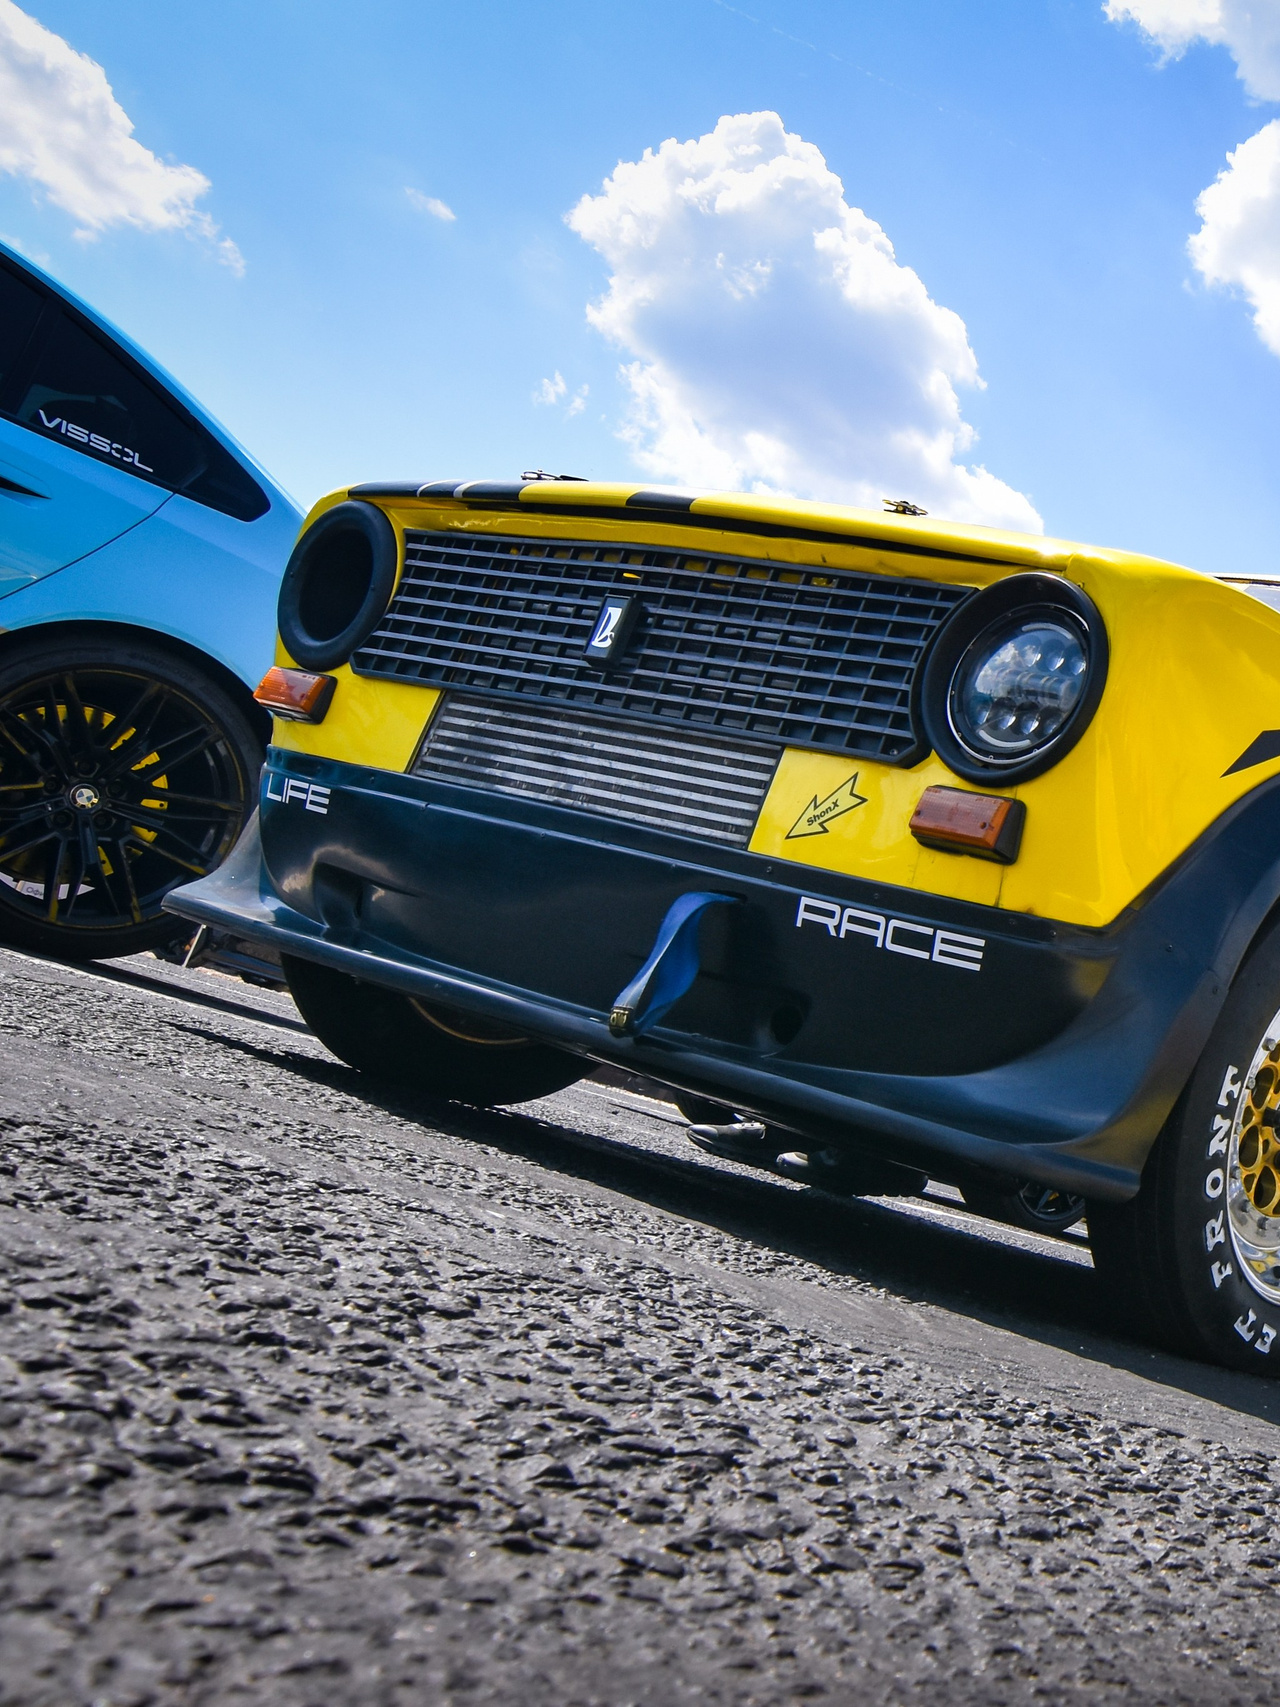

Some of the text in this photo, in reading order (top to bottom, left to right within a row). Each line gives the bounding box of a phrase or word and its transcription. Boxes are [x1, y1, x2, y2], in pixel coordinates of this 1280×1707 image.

[39, 409, 154, 473] VISSOL
[266, 773, 331, 815] LIFE
[796, 896, 986, 972] RACE
[1206, 1065, 1277, 1354] ET FRONT
